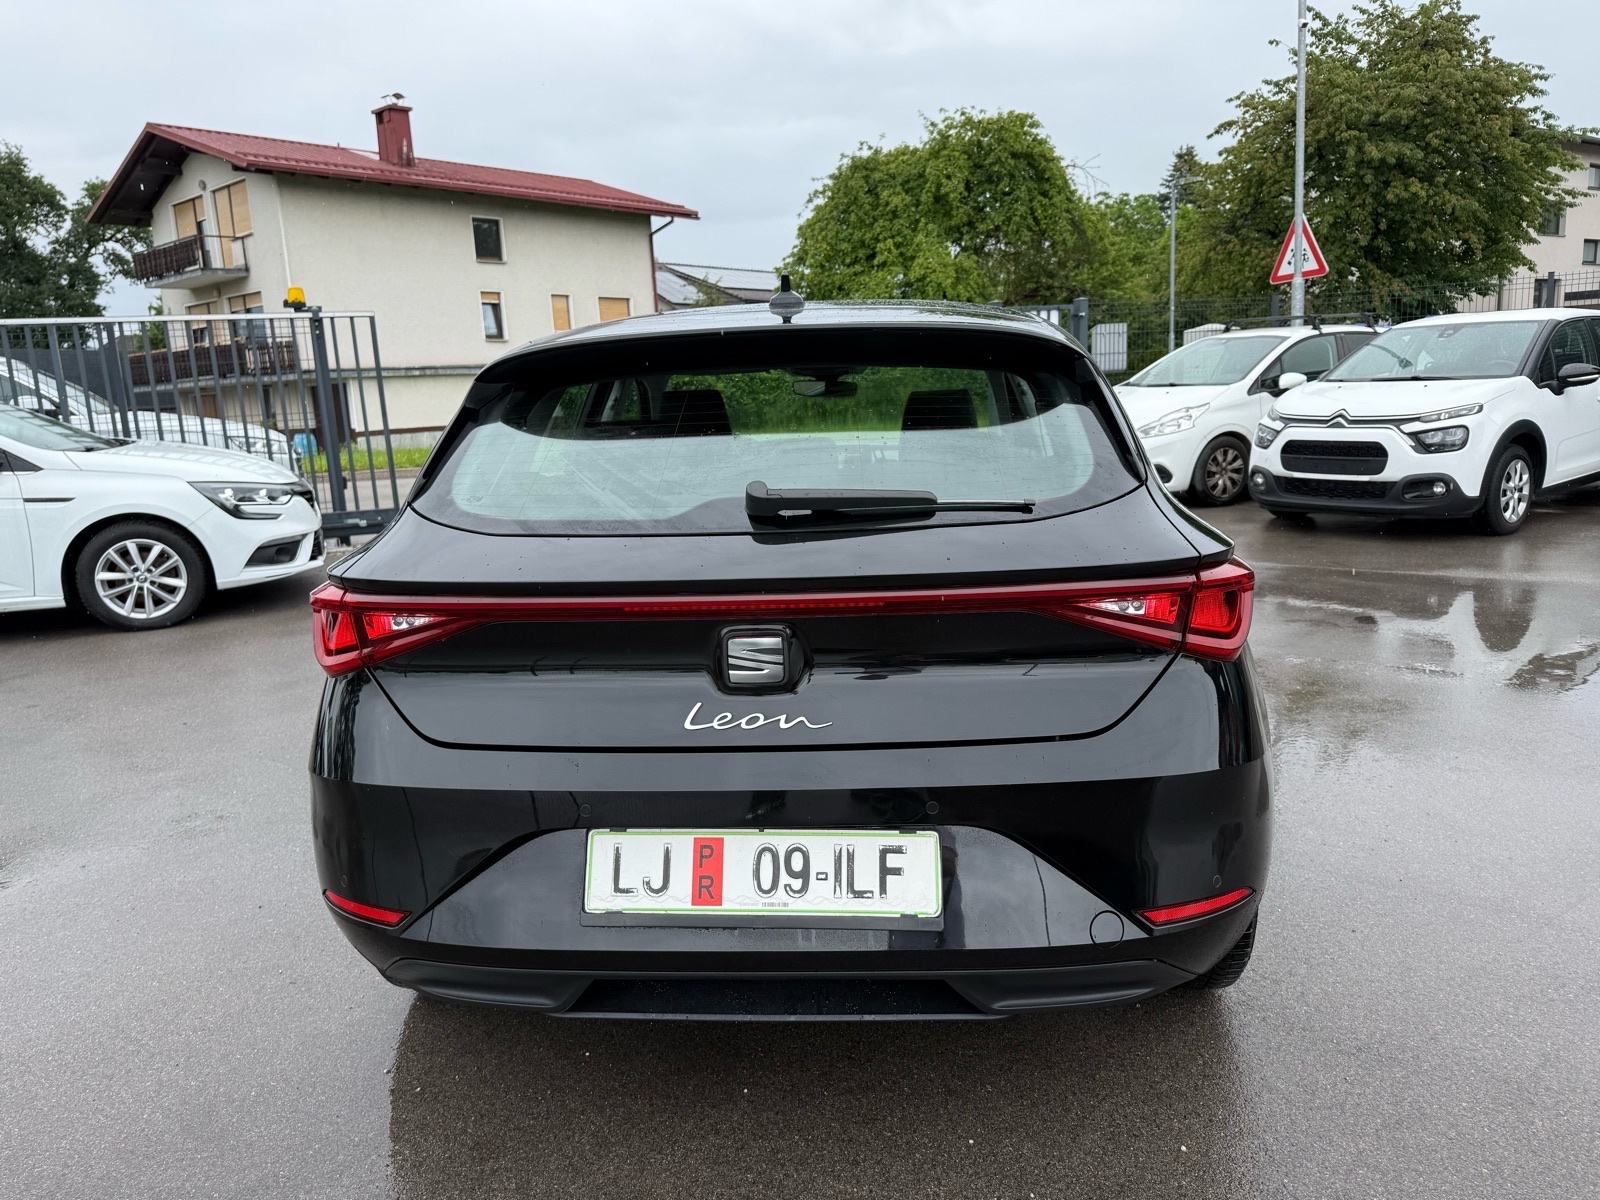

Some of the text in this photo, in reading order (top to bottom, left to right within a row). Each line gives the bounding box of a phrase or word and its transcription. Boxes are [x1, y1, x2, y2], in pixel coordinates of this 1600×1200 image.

[684, 702, 833, 730] Leon
[611, 843, 672, 897] LJ
[753, 843, 908, 899] 09-ILF
